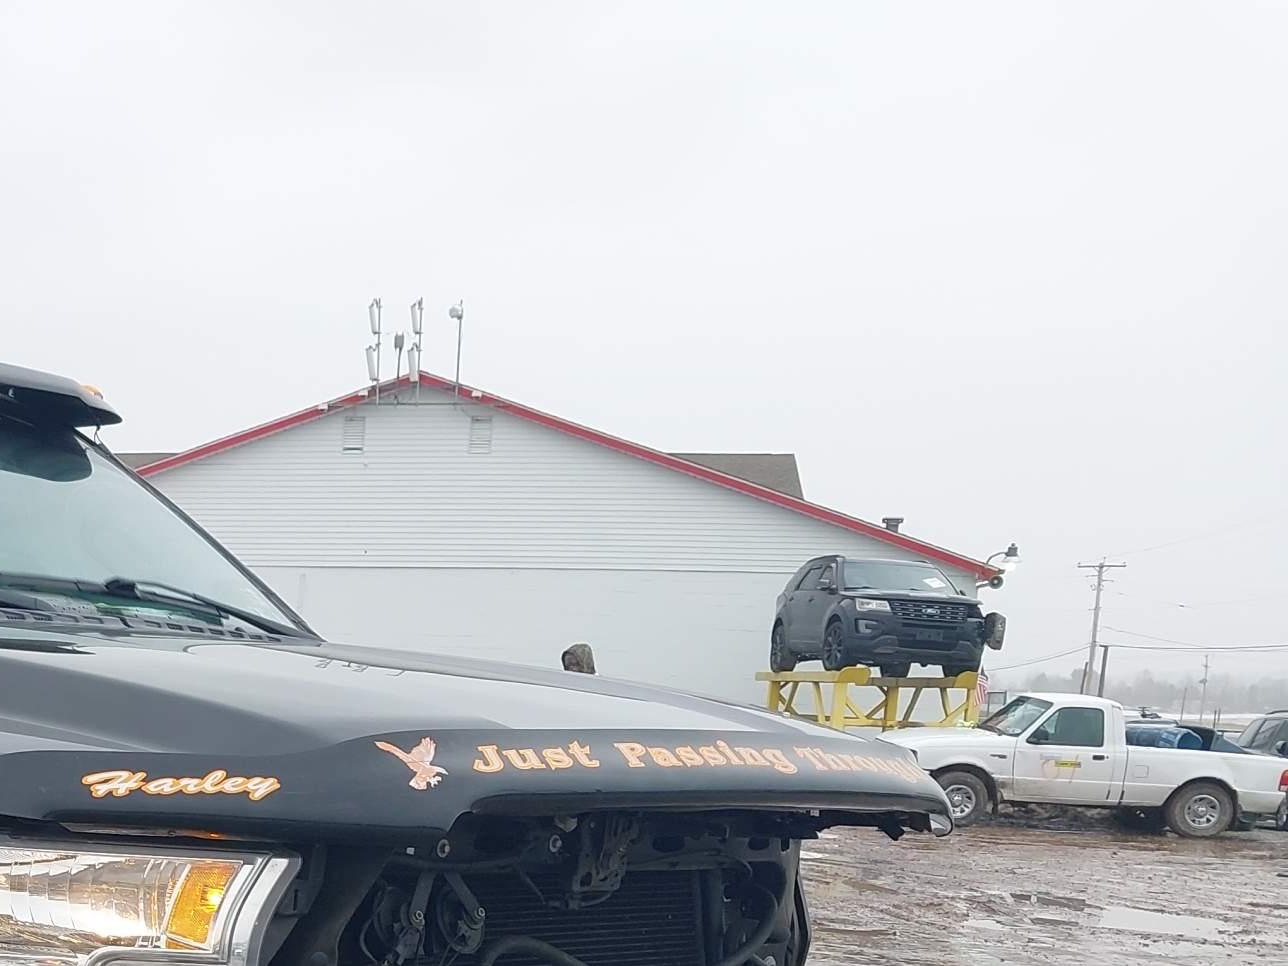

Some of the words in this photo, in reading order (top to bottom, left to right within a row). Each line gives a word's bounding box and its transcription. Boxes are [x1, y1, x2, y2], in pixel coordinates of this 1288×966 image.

[472, 740, 601, 774] Just
[613, 739, 799, 776] Passing
[81, 769, 281, 801] Harley
